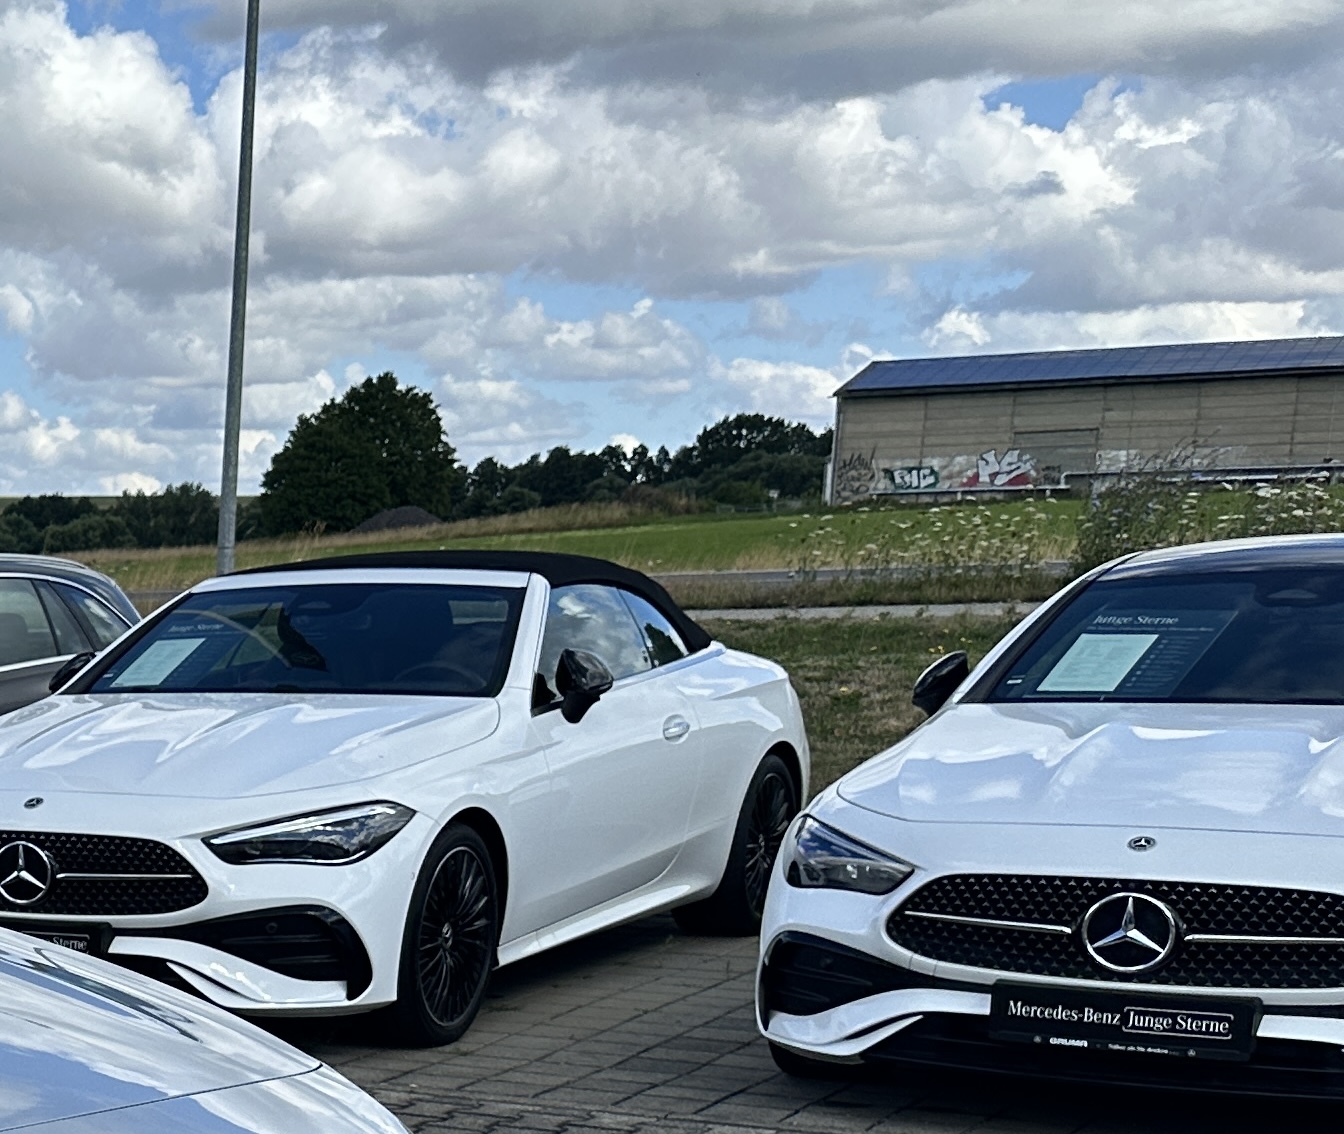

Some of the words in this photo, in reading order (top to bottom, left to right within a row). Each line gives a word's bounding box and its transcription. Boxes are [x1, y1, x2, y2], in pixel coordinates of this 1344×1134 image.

[1092, 615, 1132, 625] Junge
[1134, 614, 1179, 625] Sterne
[1008, 1000, 1120, 1025] Mercedes-Benz
[1127, 1010, 1172, 1031] Junge
[1176, 1014, 1229, 1033] Sterne
